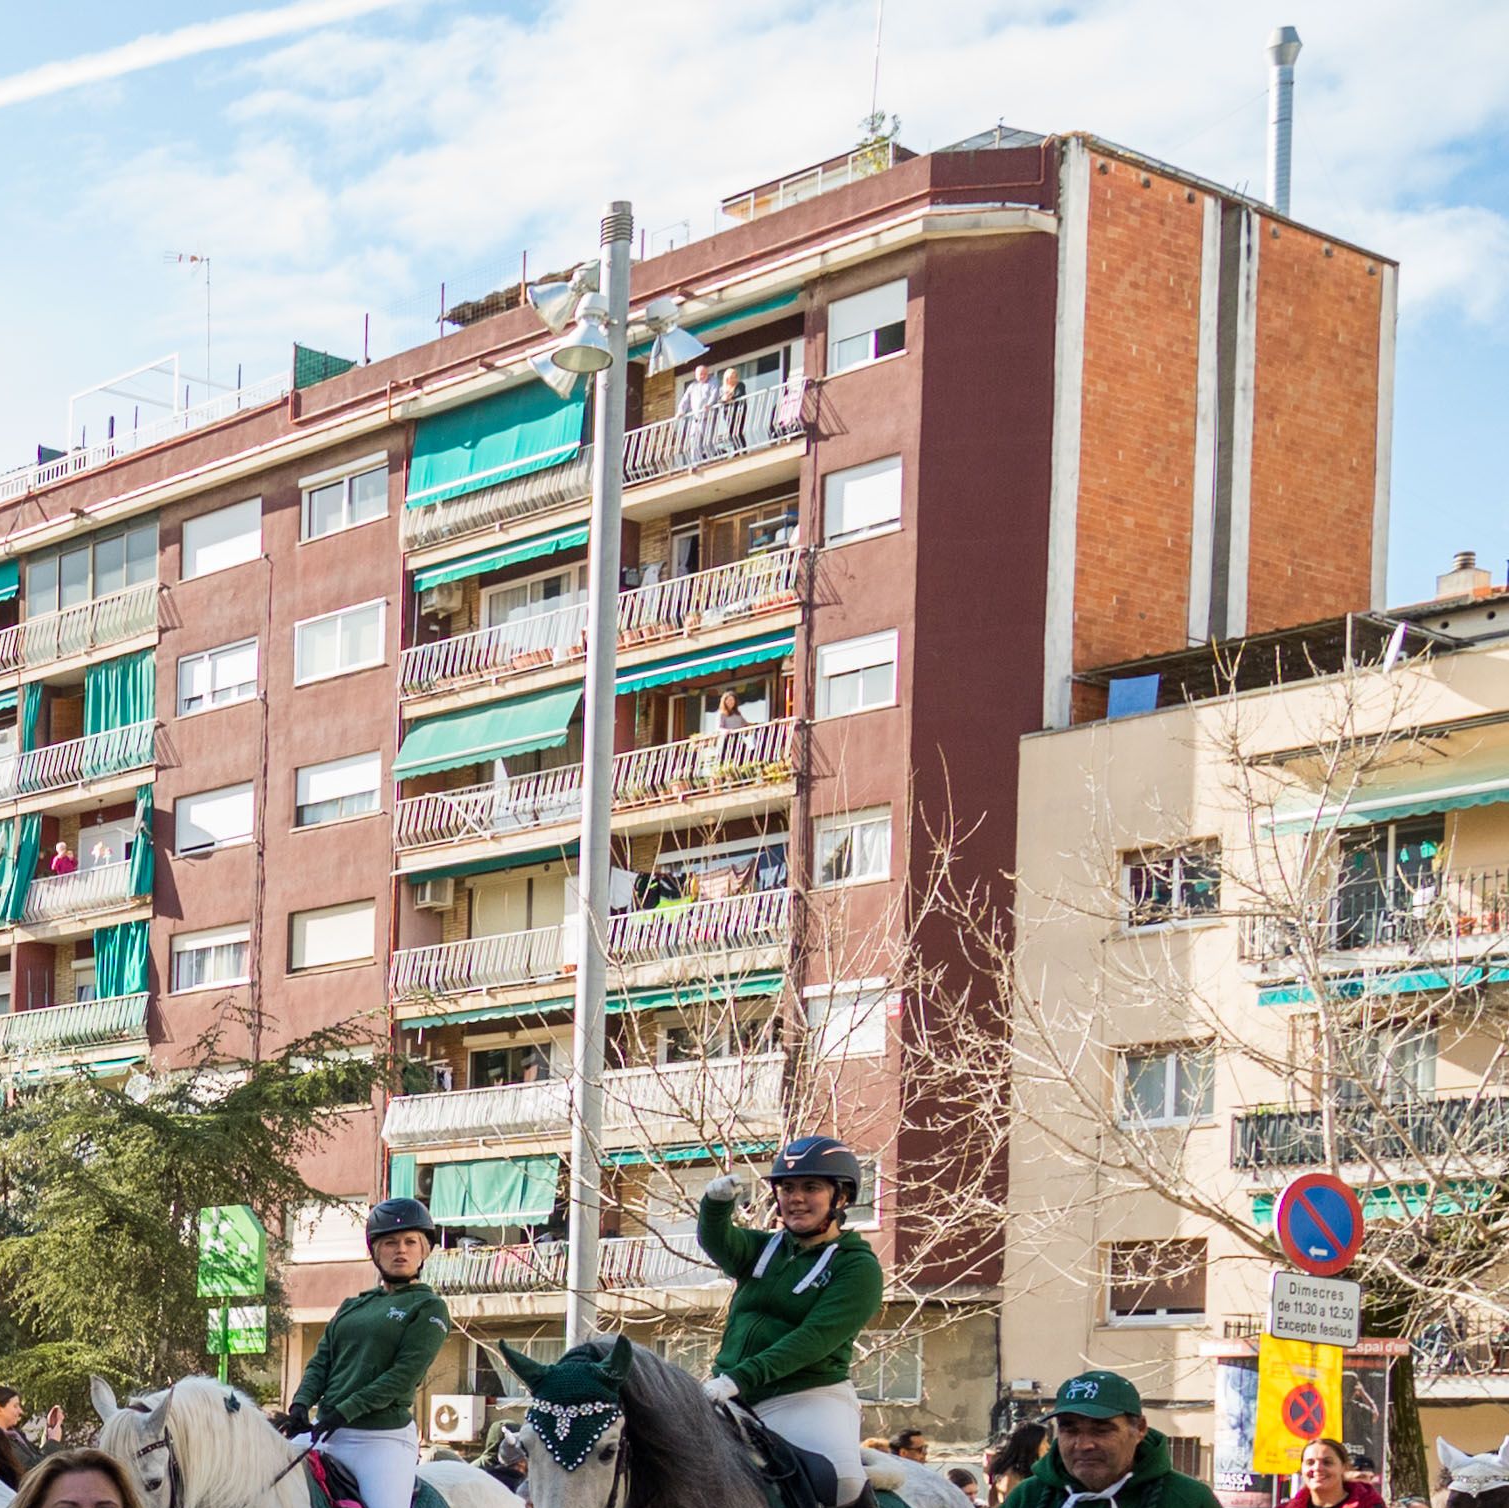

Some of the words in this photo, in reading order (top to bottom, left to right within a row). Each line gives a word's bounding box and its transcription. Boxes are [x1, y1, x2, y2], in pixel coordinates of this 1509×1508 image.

[1289, 1282, 1344, 1302] Dimecres
[1278, 1300, 1290, 1312] de
[1294, 1301, 1317, 1315] 11.30
[1319, 1307, 1326, 1317] a
[1330, 1306, 1354, 1321] 12.50
[1277, 1316, 1317, 1335] Excepte
[1319, 1322, 1353, 1339] festius
